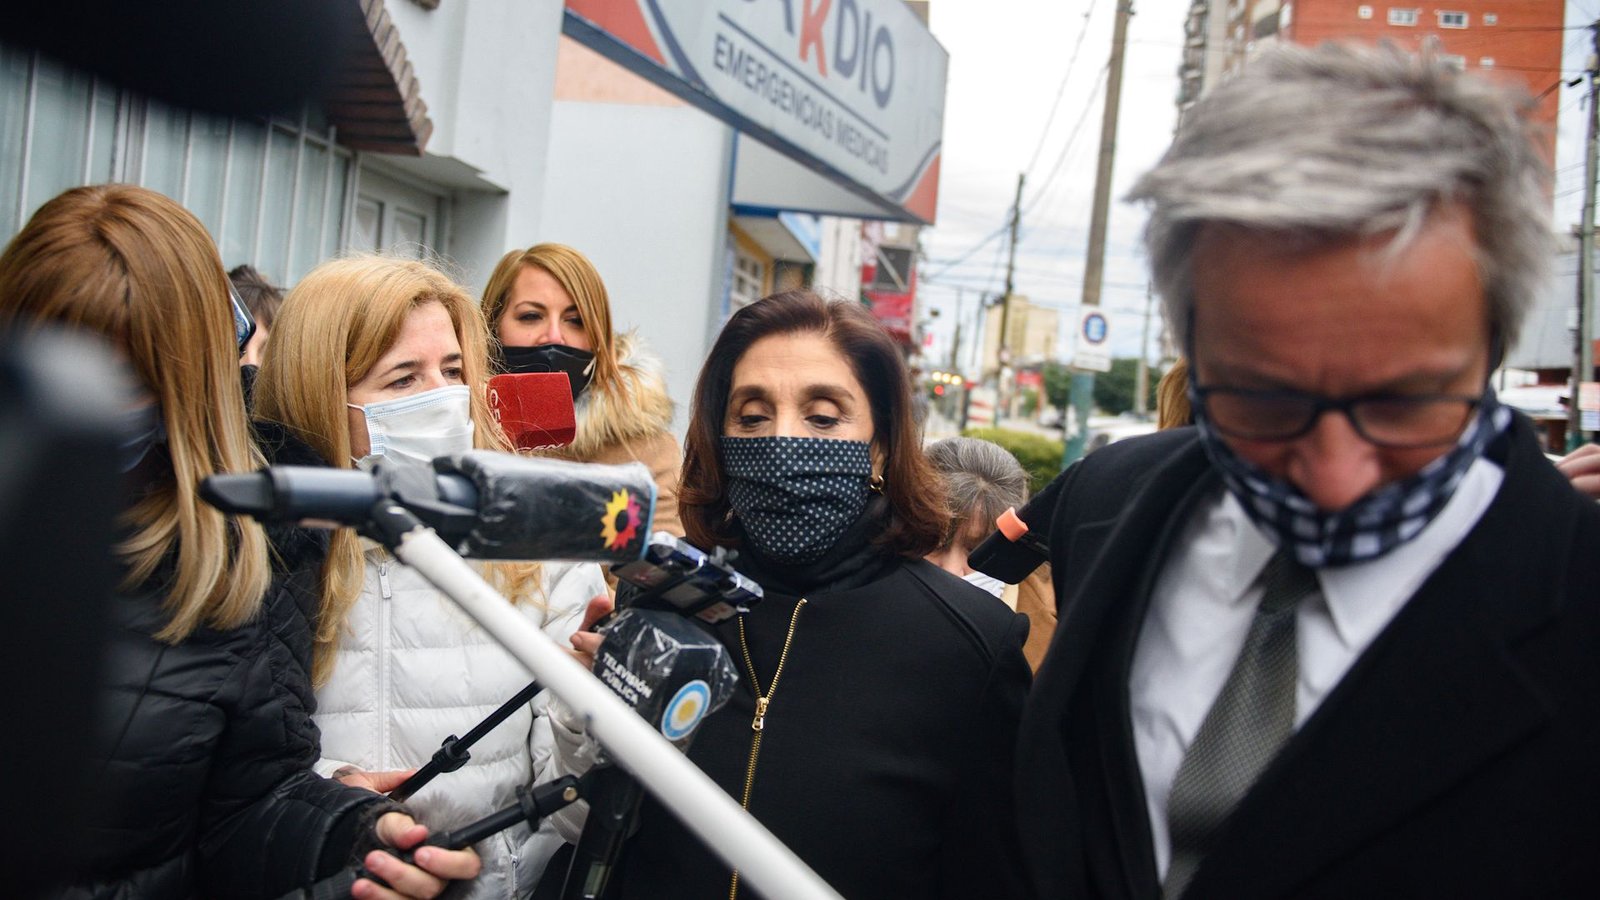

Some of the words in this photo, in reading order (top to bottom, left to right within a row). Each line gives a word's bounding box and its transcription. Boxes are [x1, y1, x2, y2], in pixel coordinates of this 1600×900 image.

[713, 33, 834, 140] EMERGENCIAS
[601, 668, 639, 705] PÚBLICA
[602, 652, 653, 699] TELEVISIÓN
